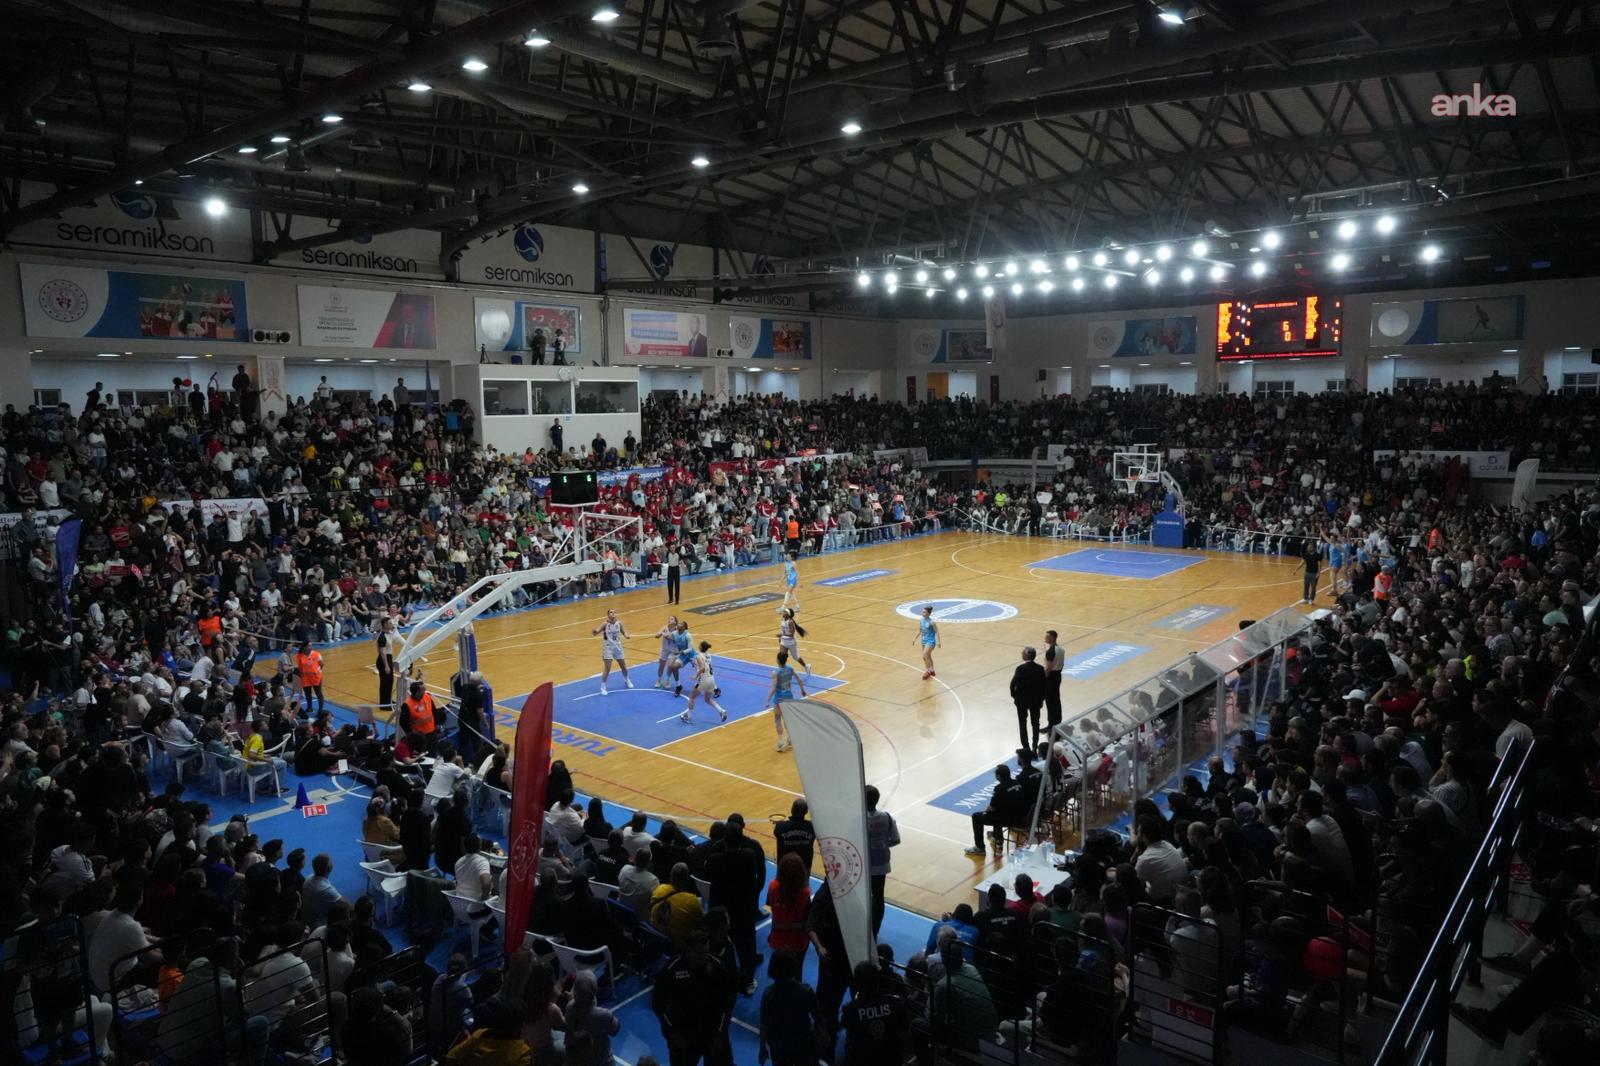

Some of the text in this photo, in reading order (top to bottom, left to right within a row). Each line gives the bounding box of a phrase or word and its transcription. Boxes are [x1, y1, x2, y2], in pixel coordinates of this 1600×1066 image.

[56, 222, 214, 254] seramiksan
[301, 248, 418, 273] seramiksan
[484, 266, 574, 287] seramiksan
